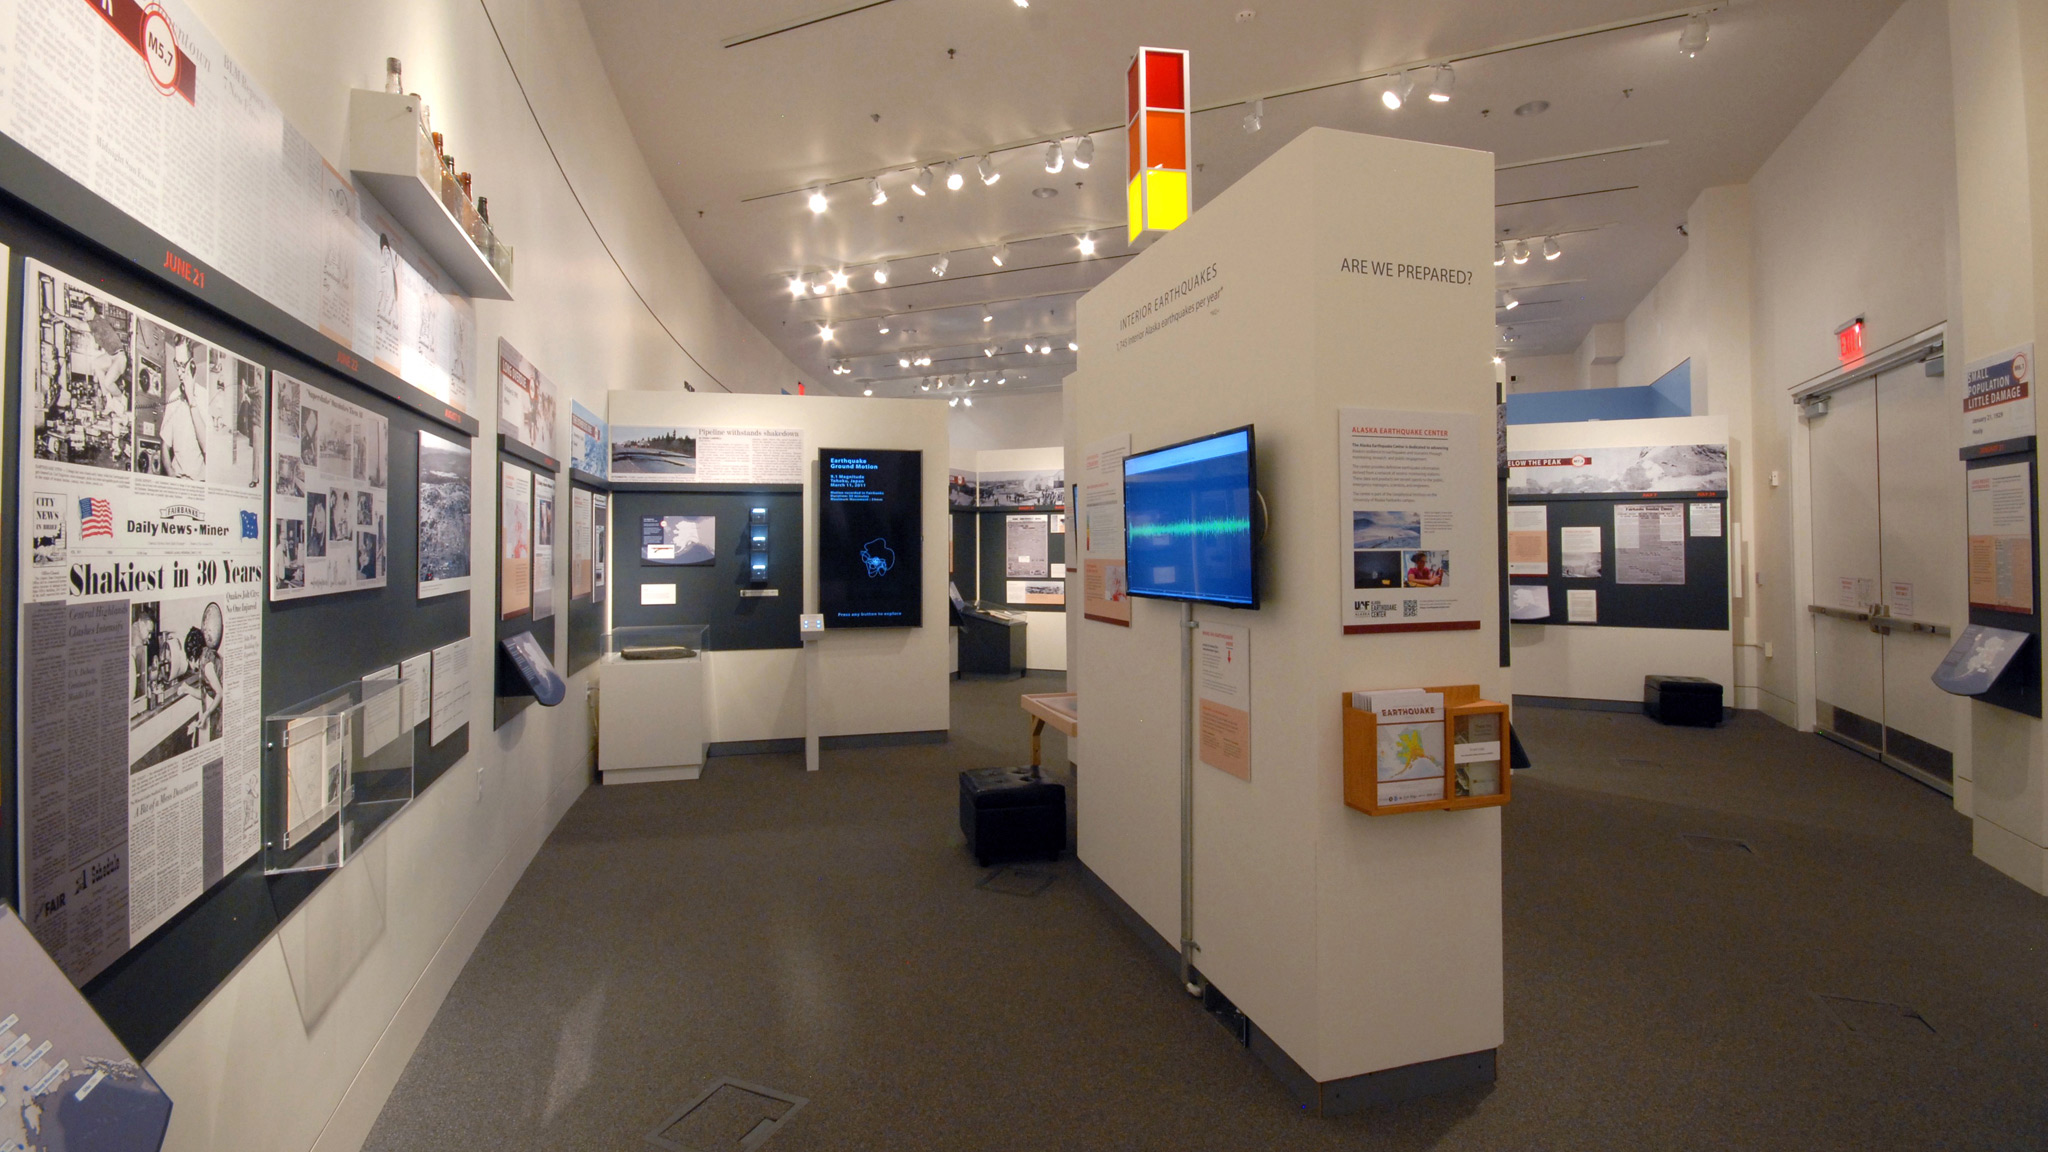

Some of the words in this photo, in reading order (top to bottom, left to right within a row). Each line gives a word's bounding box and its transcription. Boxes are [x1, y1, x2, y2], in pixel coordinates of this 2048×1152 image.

[149, 32, 173, 66] M5.7
[164, 251, 192, 282] JUNE
[193, 268, 204, 288] 21
[1341, 258, 1368, 274] ARE
[1372, 261, 1393, 277] WE
[1398, 264, 1473, 285] PREPARED?
[1120, 302, 1152, 330] INTERIOR
[1154, 263, 1217, 311] EARTHQUAKES
[1145, 322, 1160, 336] Alaska
[1161, 304, 1194, 328] earthquakes
[1195, 298, 1206, 312] per
[1968, 368, 1988, 383] SMALL
[1968, 375, 2010, 397] POPULATION
[1968, 395, 1989, 409] LITTLE
[1991, 386, 2020, 403] DAMAGE
[36, 497, 54, 506] CITY
[168, 506, 198, 517] FAIRBANKS
[36, 511, 59, 520] NEWS
[127, 520, 158, 536] Daily
[161, 522, 192, 535] News
[199, 524, 230, 536] Miner
[70, 562, 165, 596] Shakiest
[173, 561, 189, 588] in
[197, 560, 217, 586] 30
[223, 558, 262, 584] Years
[1382, 707, 1435, 716] EARTHQUAKE
[45, 893, 66, 918] FAIR
